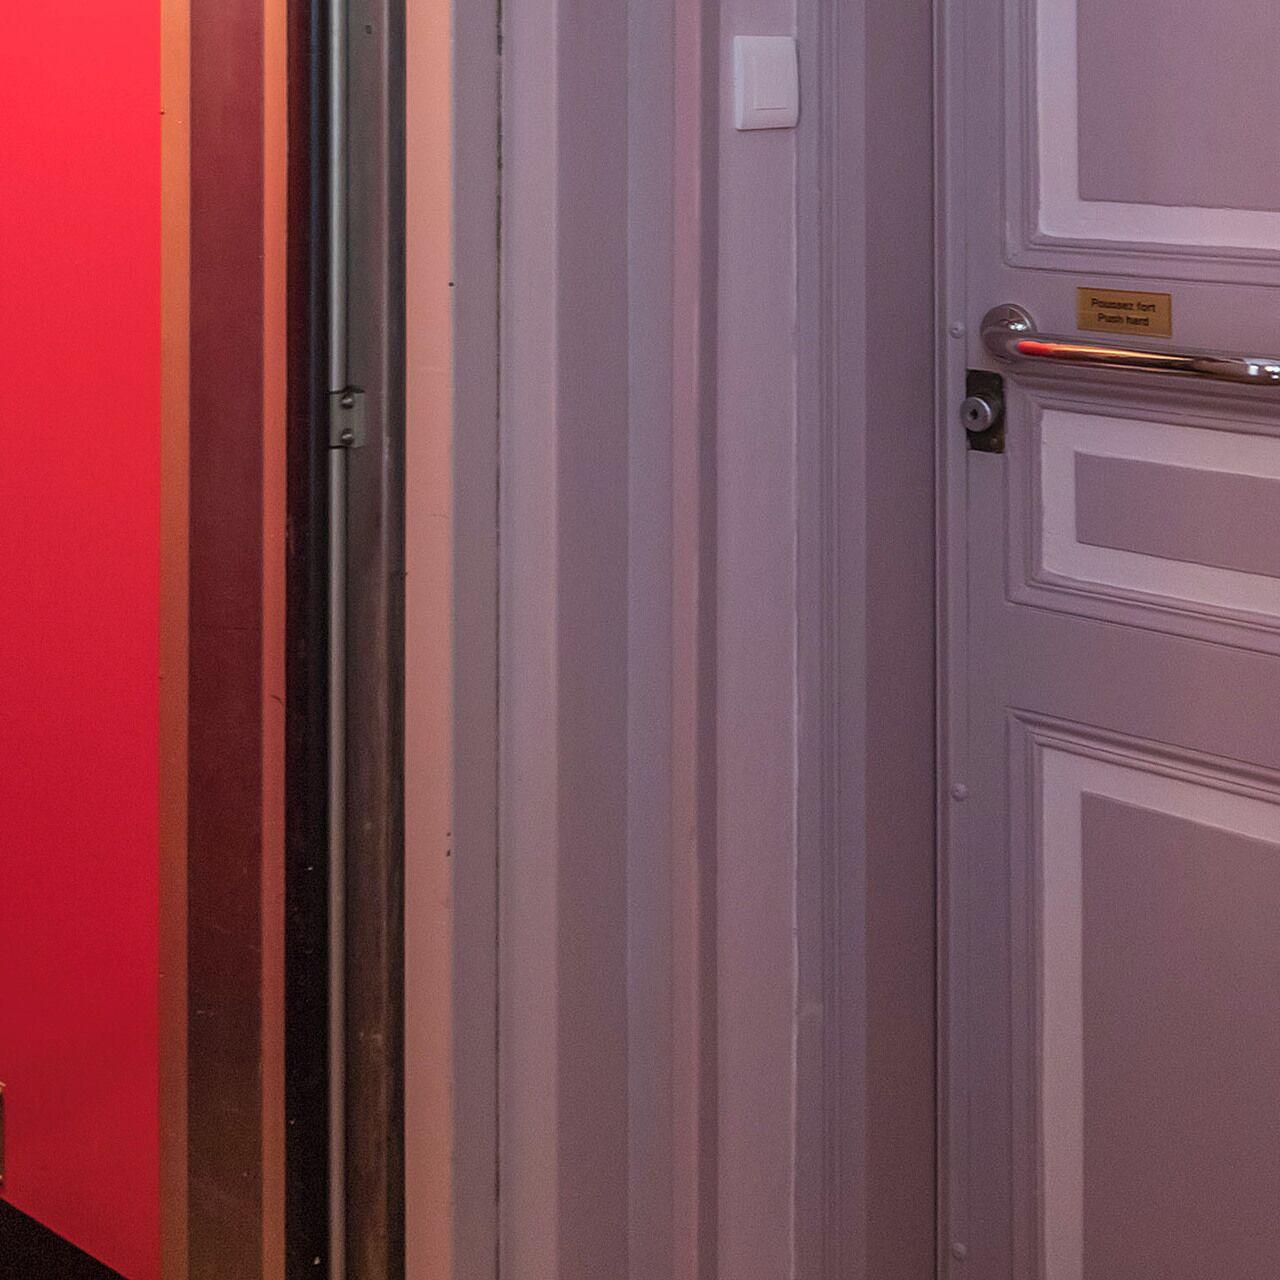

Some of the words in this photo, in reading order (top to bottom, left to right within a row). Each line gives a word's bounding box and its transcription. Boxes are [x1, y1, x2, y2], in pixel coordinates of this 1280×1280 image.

[1091, 297, 1134, 311] Poussez
[1136, 301, 1156, 313] fort
[1097, 312, 1124, 324] Push
[1126, 315, 1150, 327] hard
